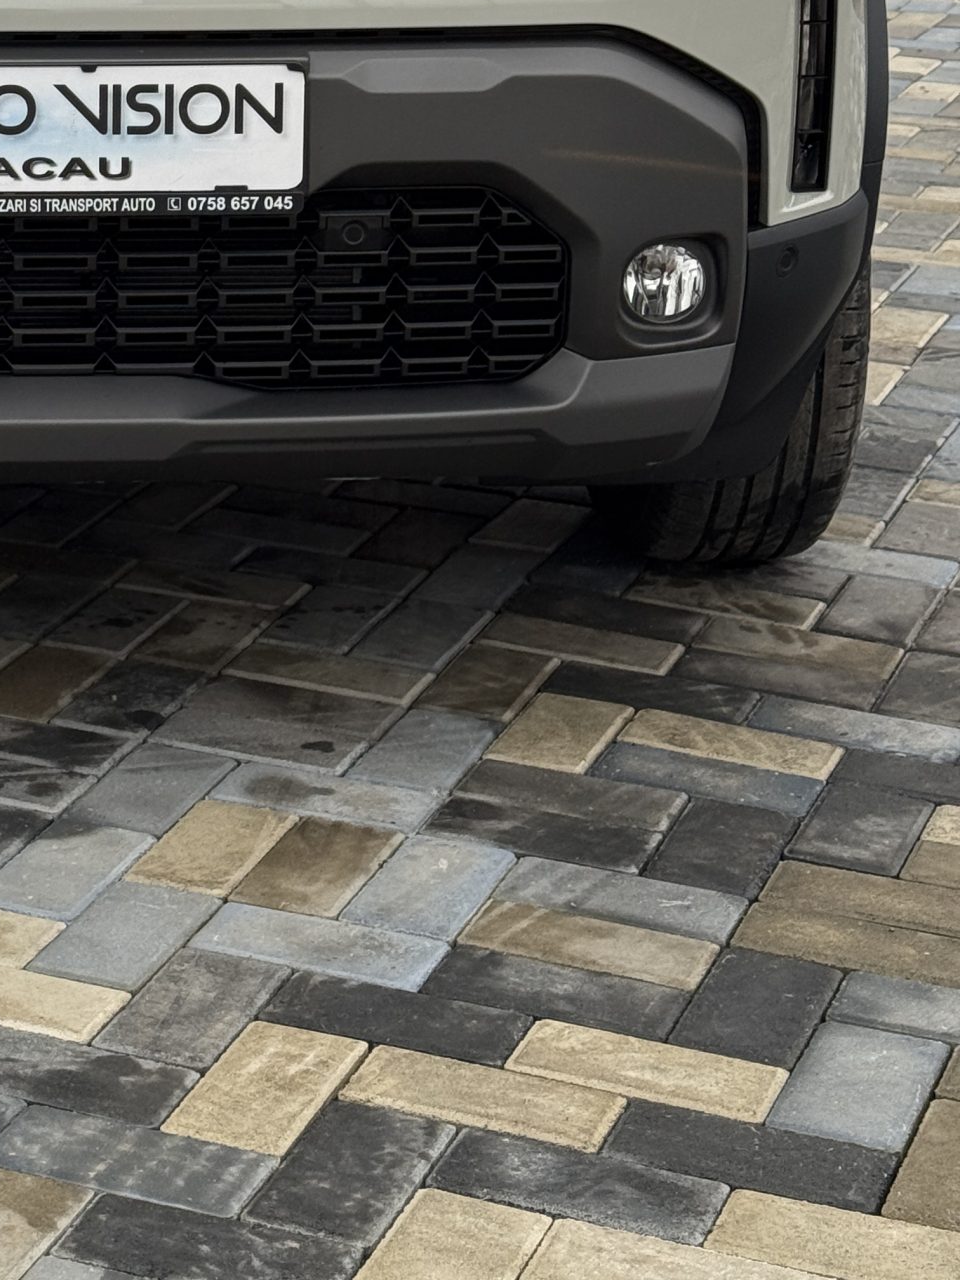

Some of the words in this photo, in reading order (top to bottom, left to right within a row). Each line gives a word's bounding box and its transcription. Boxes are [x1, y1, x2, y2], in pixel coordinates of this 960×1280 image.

[54, 82, 285, 135] VISION
[29, 198, 41, 212] SI
[44, 198, 118, 212] TRANSPORT
[121, 198, 156, 212] AUTO
[187, 196, 226, 211] 0758
[230, 196, 259, 211] 657
[263, 195, 293, 210] 045
